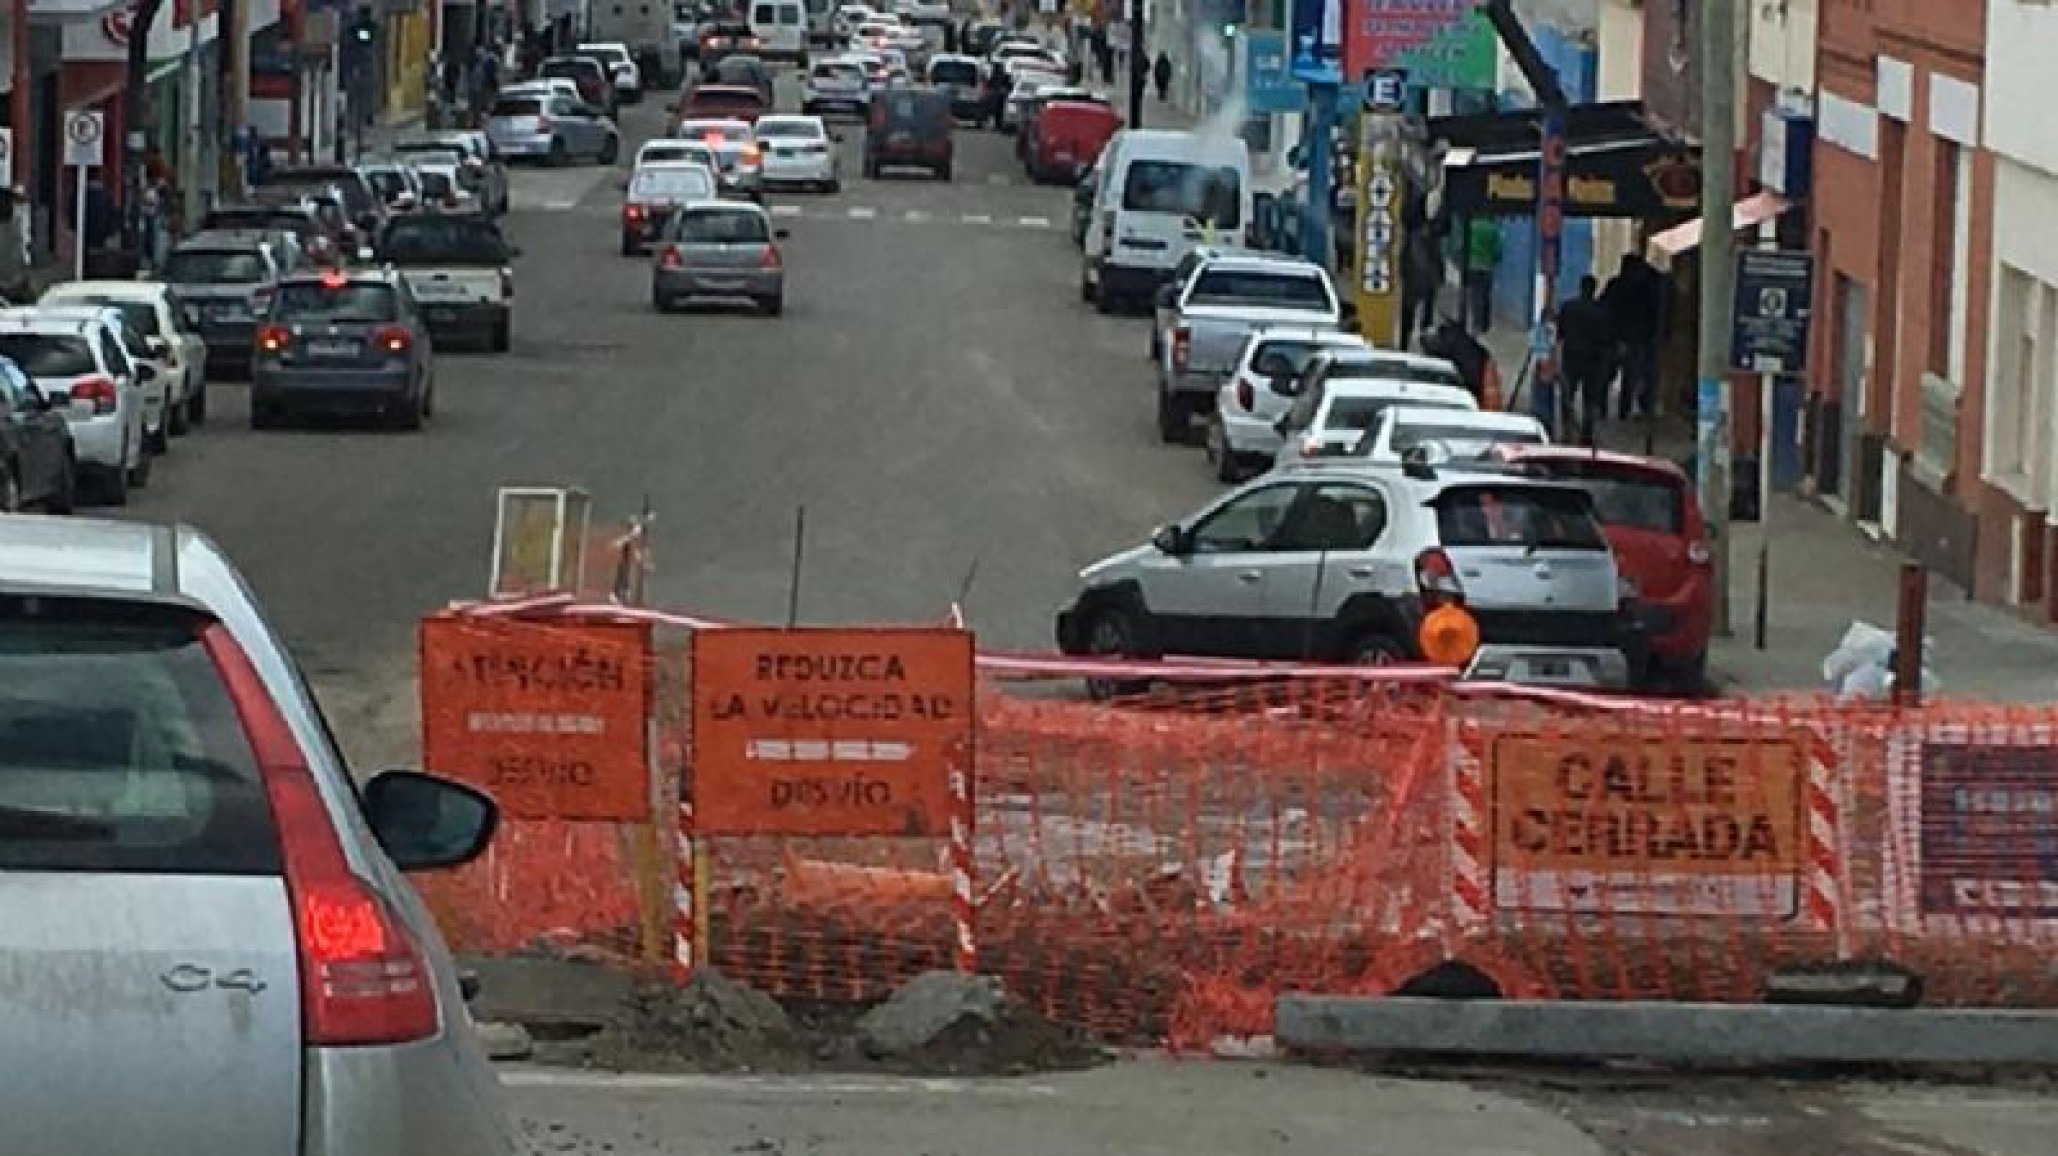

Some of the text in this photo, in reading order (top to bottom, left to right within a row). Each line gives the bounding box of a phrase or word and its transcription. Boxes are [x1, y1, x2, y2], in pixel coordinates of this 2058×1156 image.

[757, 654, 905, 681] REDUZCA
[711, 694, 953, 721] LA VELOCIDAD
[771, 771, 891, 806] DESVÍO
[1555, 753, 1737, 804] CALLE
[1511, 807, 1779, 861] CERRADA
[159, 962, 268, 996] C4
